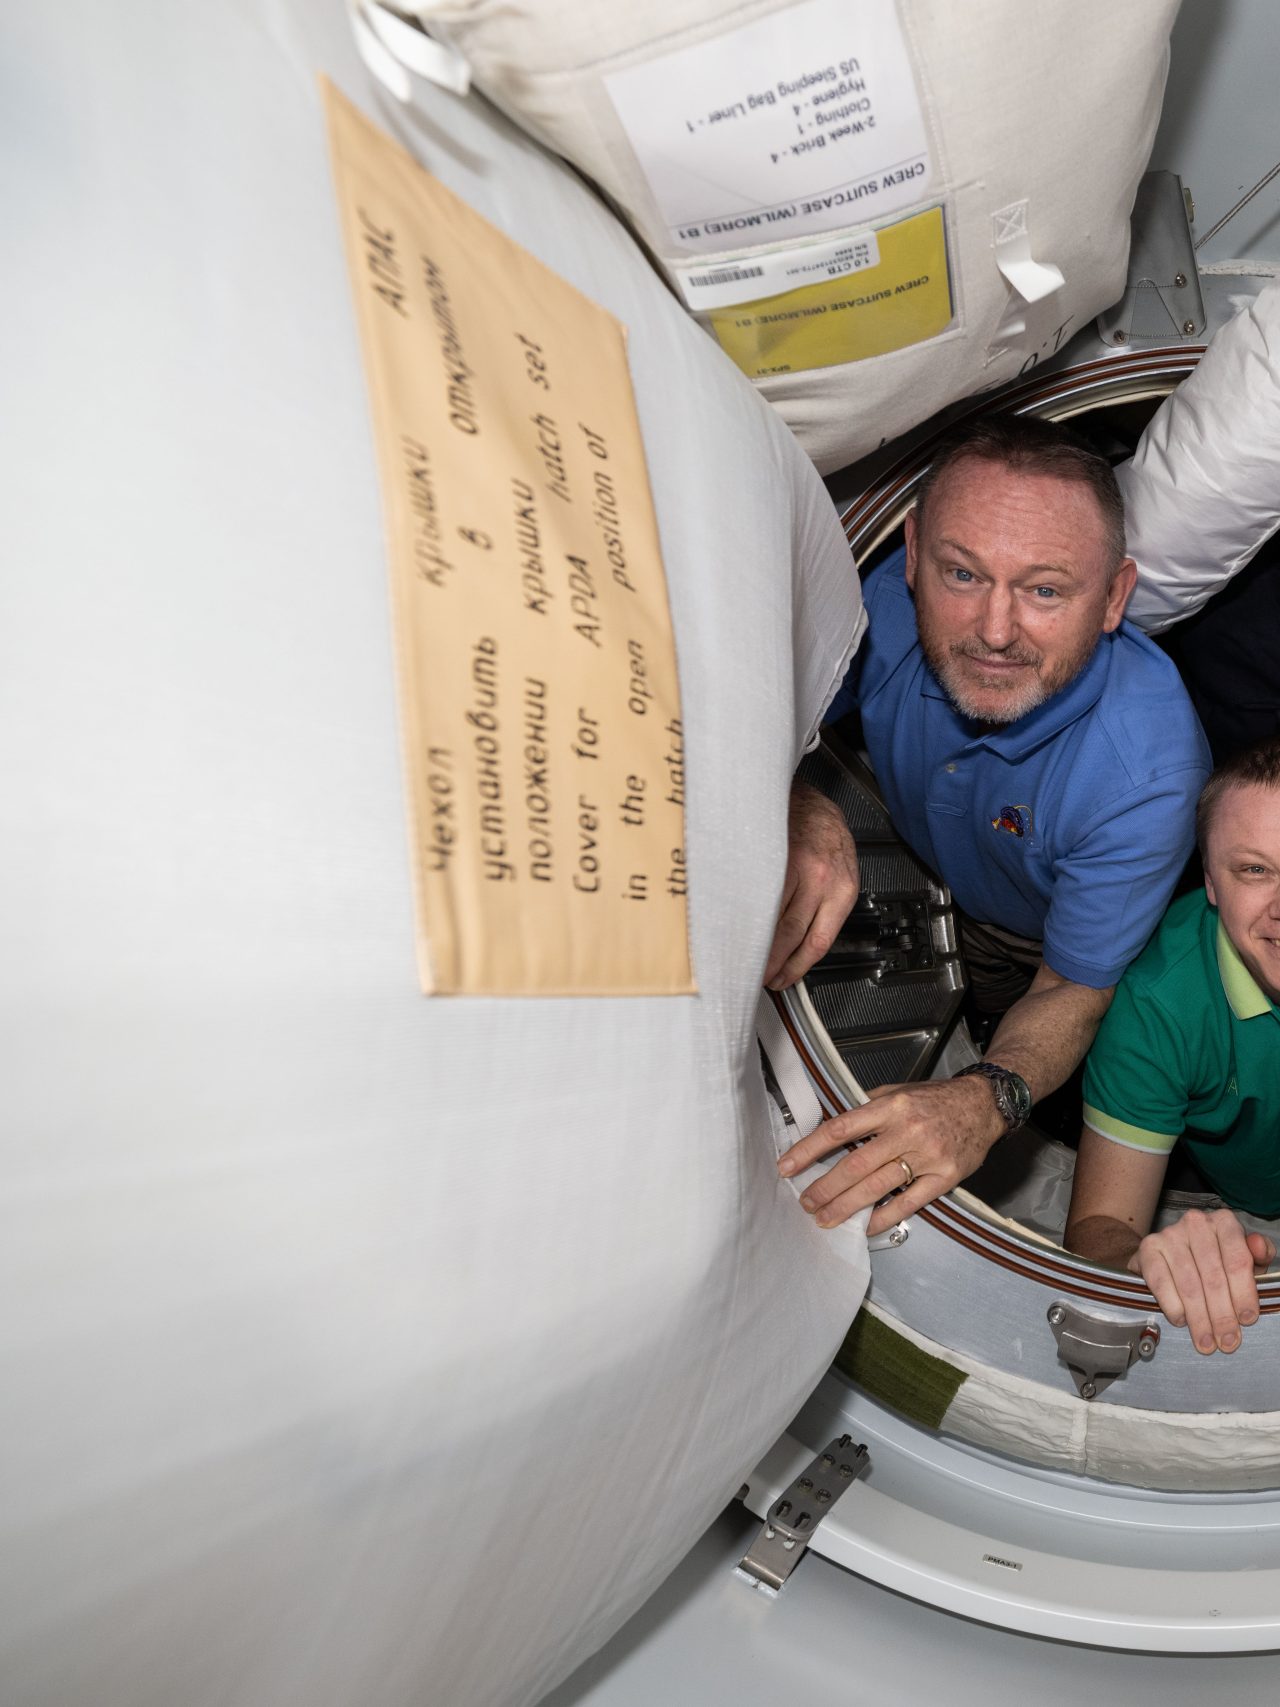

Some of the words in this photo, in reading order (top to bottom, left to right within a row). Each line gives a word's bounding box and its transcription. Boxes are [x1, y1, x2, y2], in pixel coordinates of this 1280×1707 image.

[779, 65, 837, 97] Sleeping
[840, 57, 860, 76] US
[746, 83, 777, 110] Bag
[812, 77, 866, 107] Hygiene
[686, 119, 695, 134] 1
[708, 103, 746, 125] Liner
[792, 103, 801, 118] 4
[815, 97, 871, 125] Clothing
[793, 133, 829, 156] Brick
[797, 121, 805, 136] 1
[831, 115, 876, 143] 2-Week
[770, 151, 779, 165] 4
[882, 161, 926, 190] CREW
[801, 179, 879, 216] SUITCASE
[679, 224, 701, 241] B1
[705, 204, 798, 237] (WILMORE)
[356, 206, 410, 319] АПАС
[827, 259, 852, 276] CTB
[831, 286, 892, 310] SUITCASE
[893, 275, 929, 296] CREW
[513, 331, 551, 391] set
[577, 421, 610, 461] of
[528, 412, 571, 503] hatch
[400, 434, 456, 587] крышки
[511, 477, 556, 616] крышки
[592, 467, 638, 594] position
[564, 553, 604, 649] APDA
[627, 637, 656, 717] open
[570, 706, 601, 761] for
[465, 634, 518, 884] установить
[522, 676, 553, 884] положении
[427, 745, 458, 873] Чехол
[619, 773, 649, 829] the
[572, 793, 601, 895] Cover
[620, 871, 649, 902] in
[665, 846, 690, 900] the
